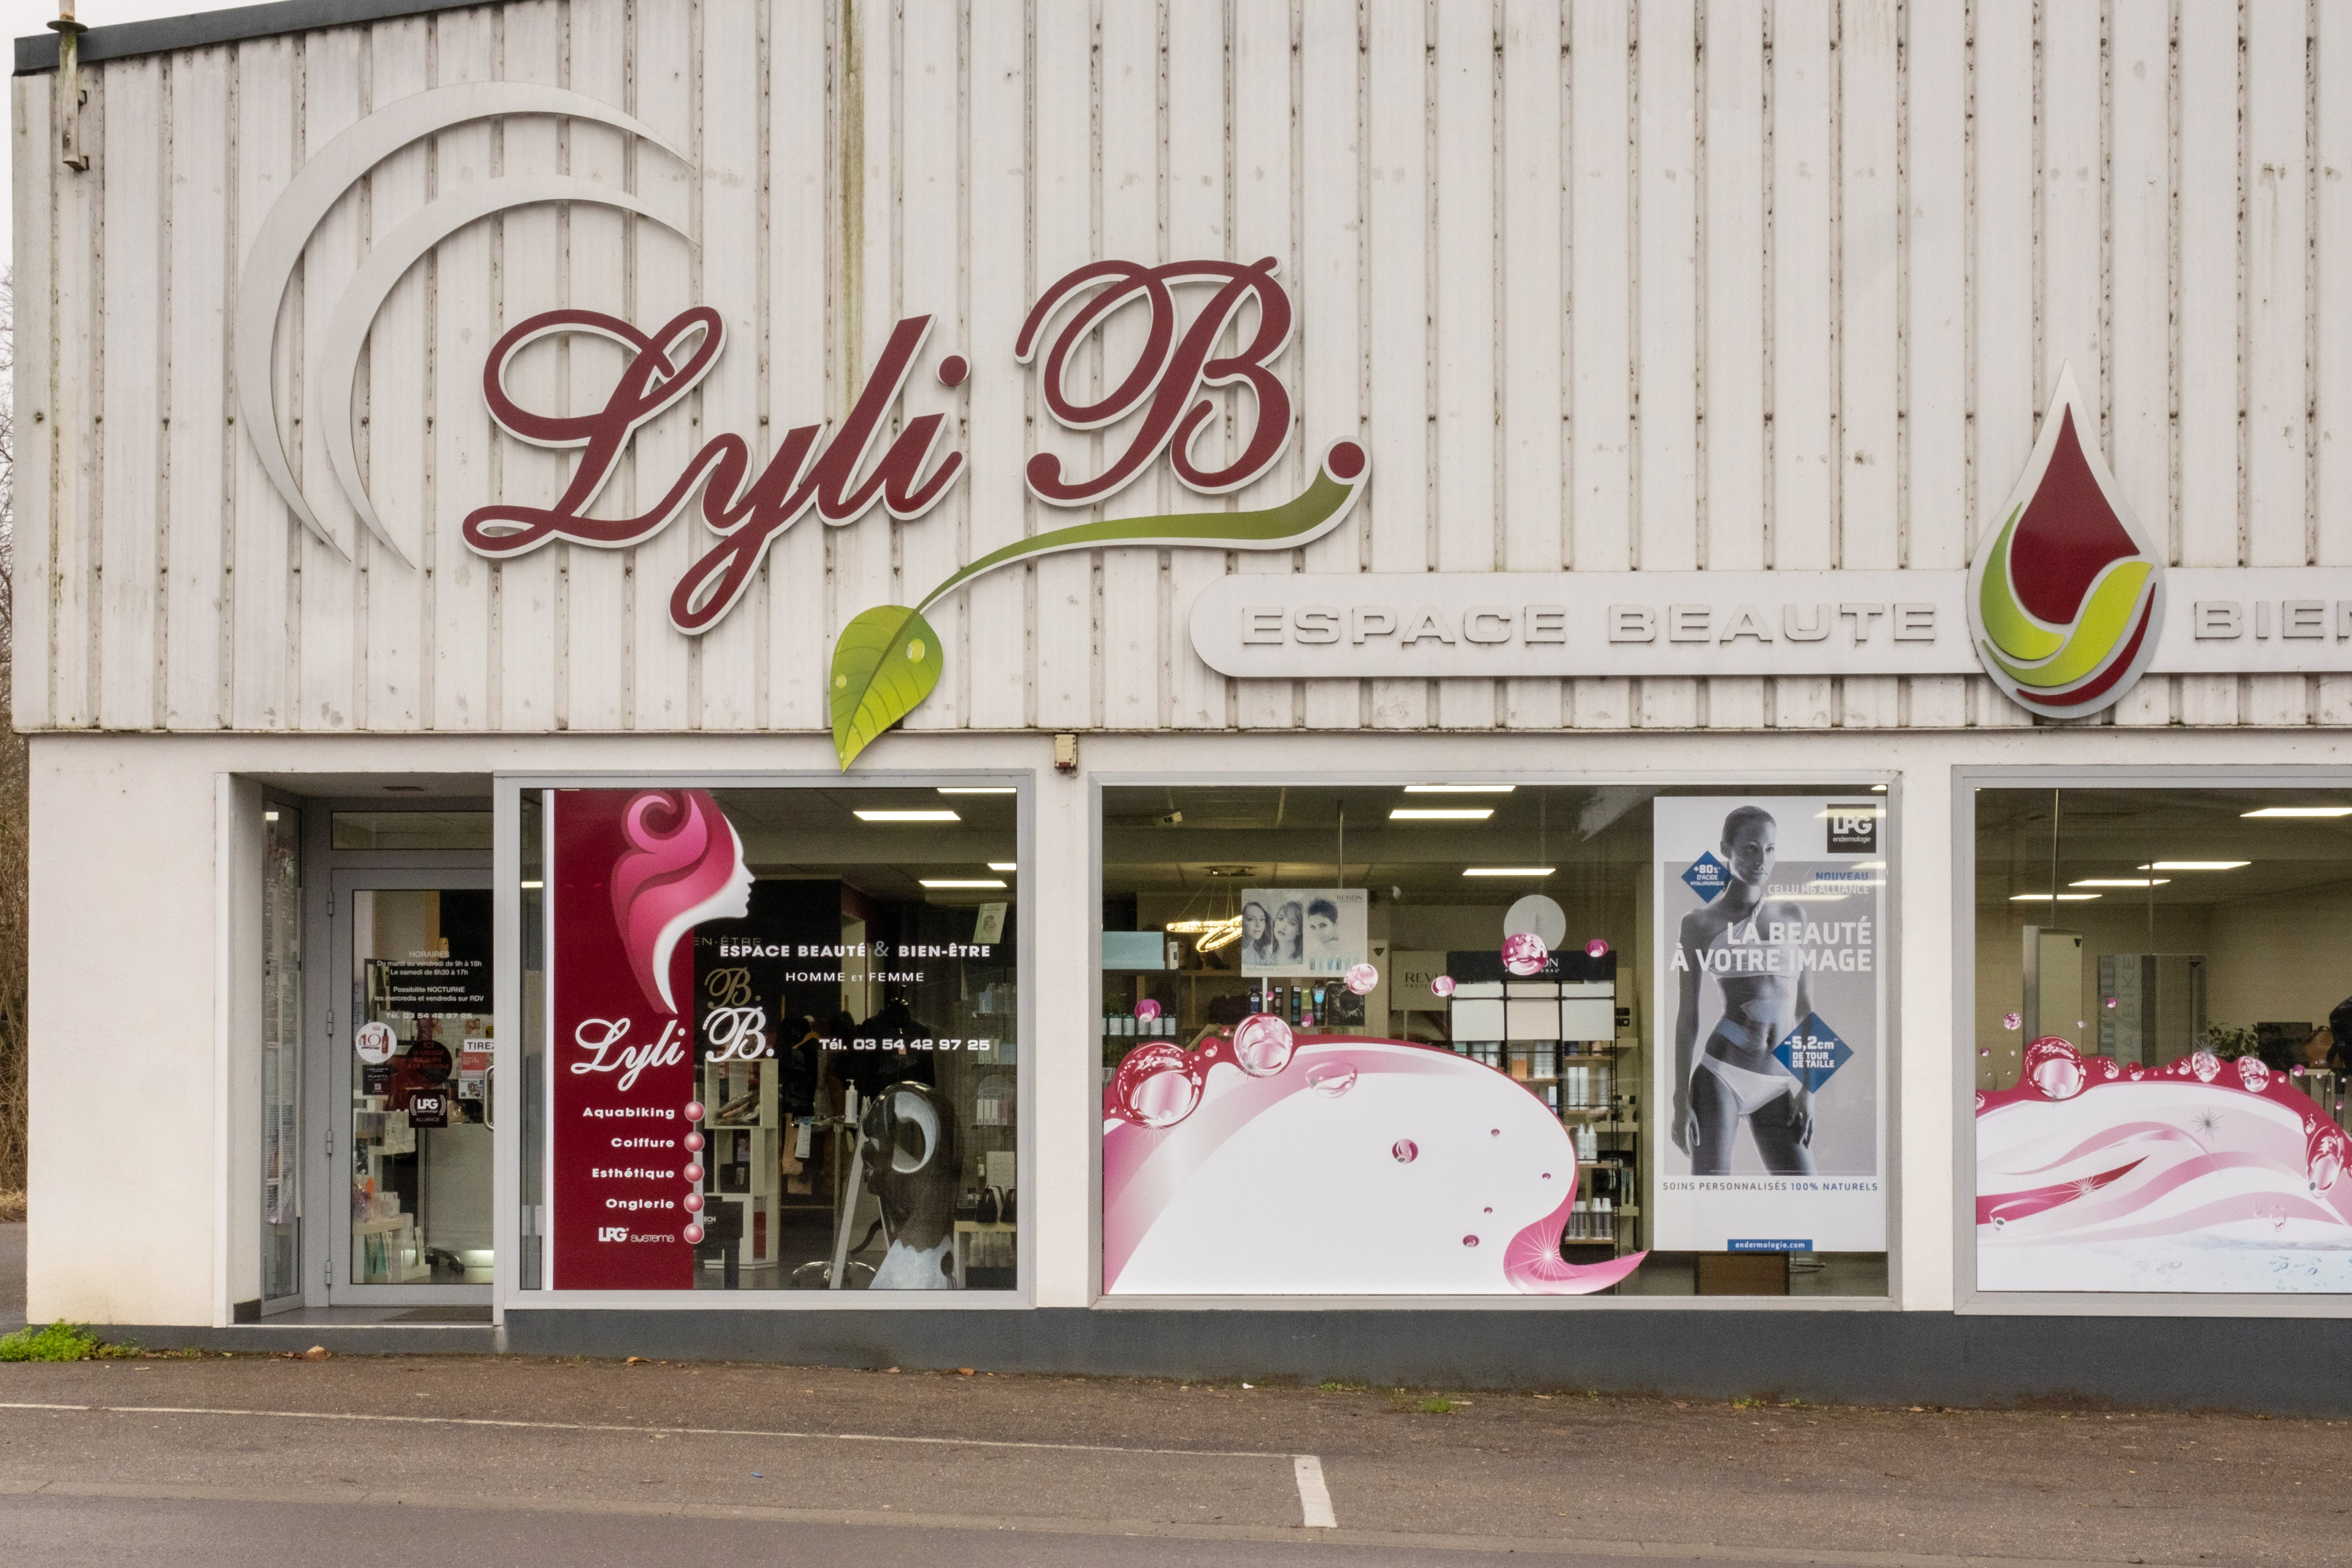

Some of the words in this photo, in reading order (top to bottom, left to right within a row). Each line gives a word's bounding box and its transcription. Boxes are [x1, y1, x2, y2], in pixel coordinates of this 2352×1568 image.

[462, 306, 970, 634] Lyli
[1243, 605, 1566, 643] ESPACE
[1609, 603, 1936, 643] BEAUTE
[1833, 816, 1872, 834] LPG
[1815, 872, 1868, 880] NOUVEAU
[1768, 884, 1799, 894] CELLU
[1802, 884, 1816, 894] M6
[1818, 884, 1869, 894] ALLIANCE
[1727, 922, 1761, 945] LA
[1769, 916, 1872, 945] BEAUTÉ
[720, 945, 790, 957] ESPACE
[798, 942, 866, 957] BEAUTÉ
[873, 940, 889, 957] &
[898, 942, 991, 957] BIEN-ÊTRE
[1669, 943, 1689, 971] À
[1696, 949, 1781, 971] VOTRE
[1789, 949, 1872, 971] IMAGE
[786, 972, 846, 982] HOMME
[869, 972, 925, 982] FEMME
[570, 1018, 686, 1091] Lyli
[702, 1007, 775, 1063] B.
[819, 1038, 847, 1051] Tél.
[853, 1039, 876, 1051] 03
[882, 1039, 905, 1051] 54
[910, 1039, 933, 1051] 42
[939, 1039, 962, 1051] 97
[967, 1039, 990, 1051] 25
[417, 1098, 439, 1109] LPG
[583, 1107, 675, 1119] Aquabiking
[611, 1137, 675, 1148] Coiffure
[592, 1168, 675, 1180] Esthétique
[1699, 1181, 1787, 1190] PERSONNALISÉS
[606, 1198, 675, 1211] Onglerie
[1735, 1241, 1805, 1250] endermologie.com
